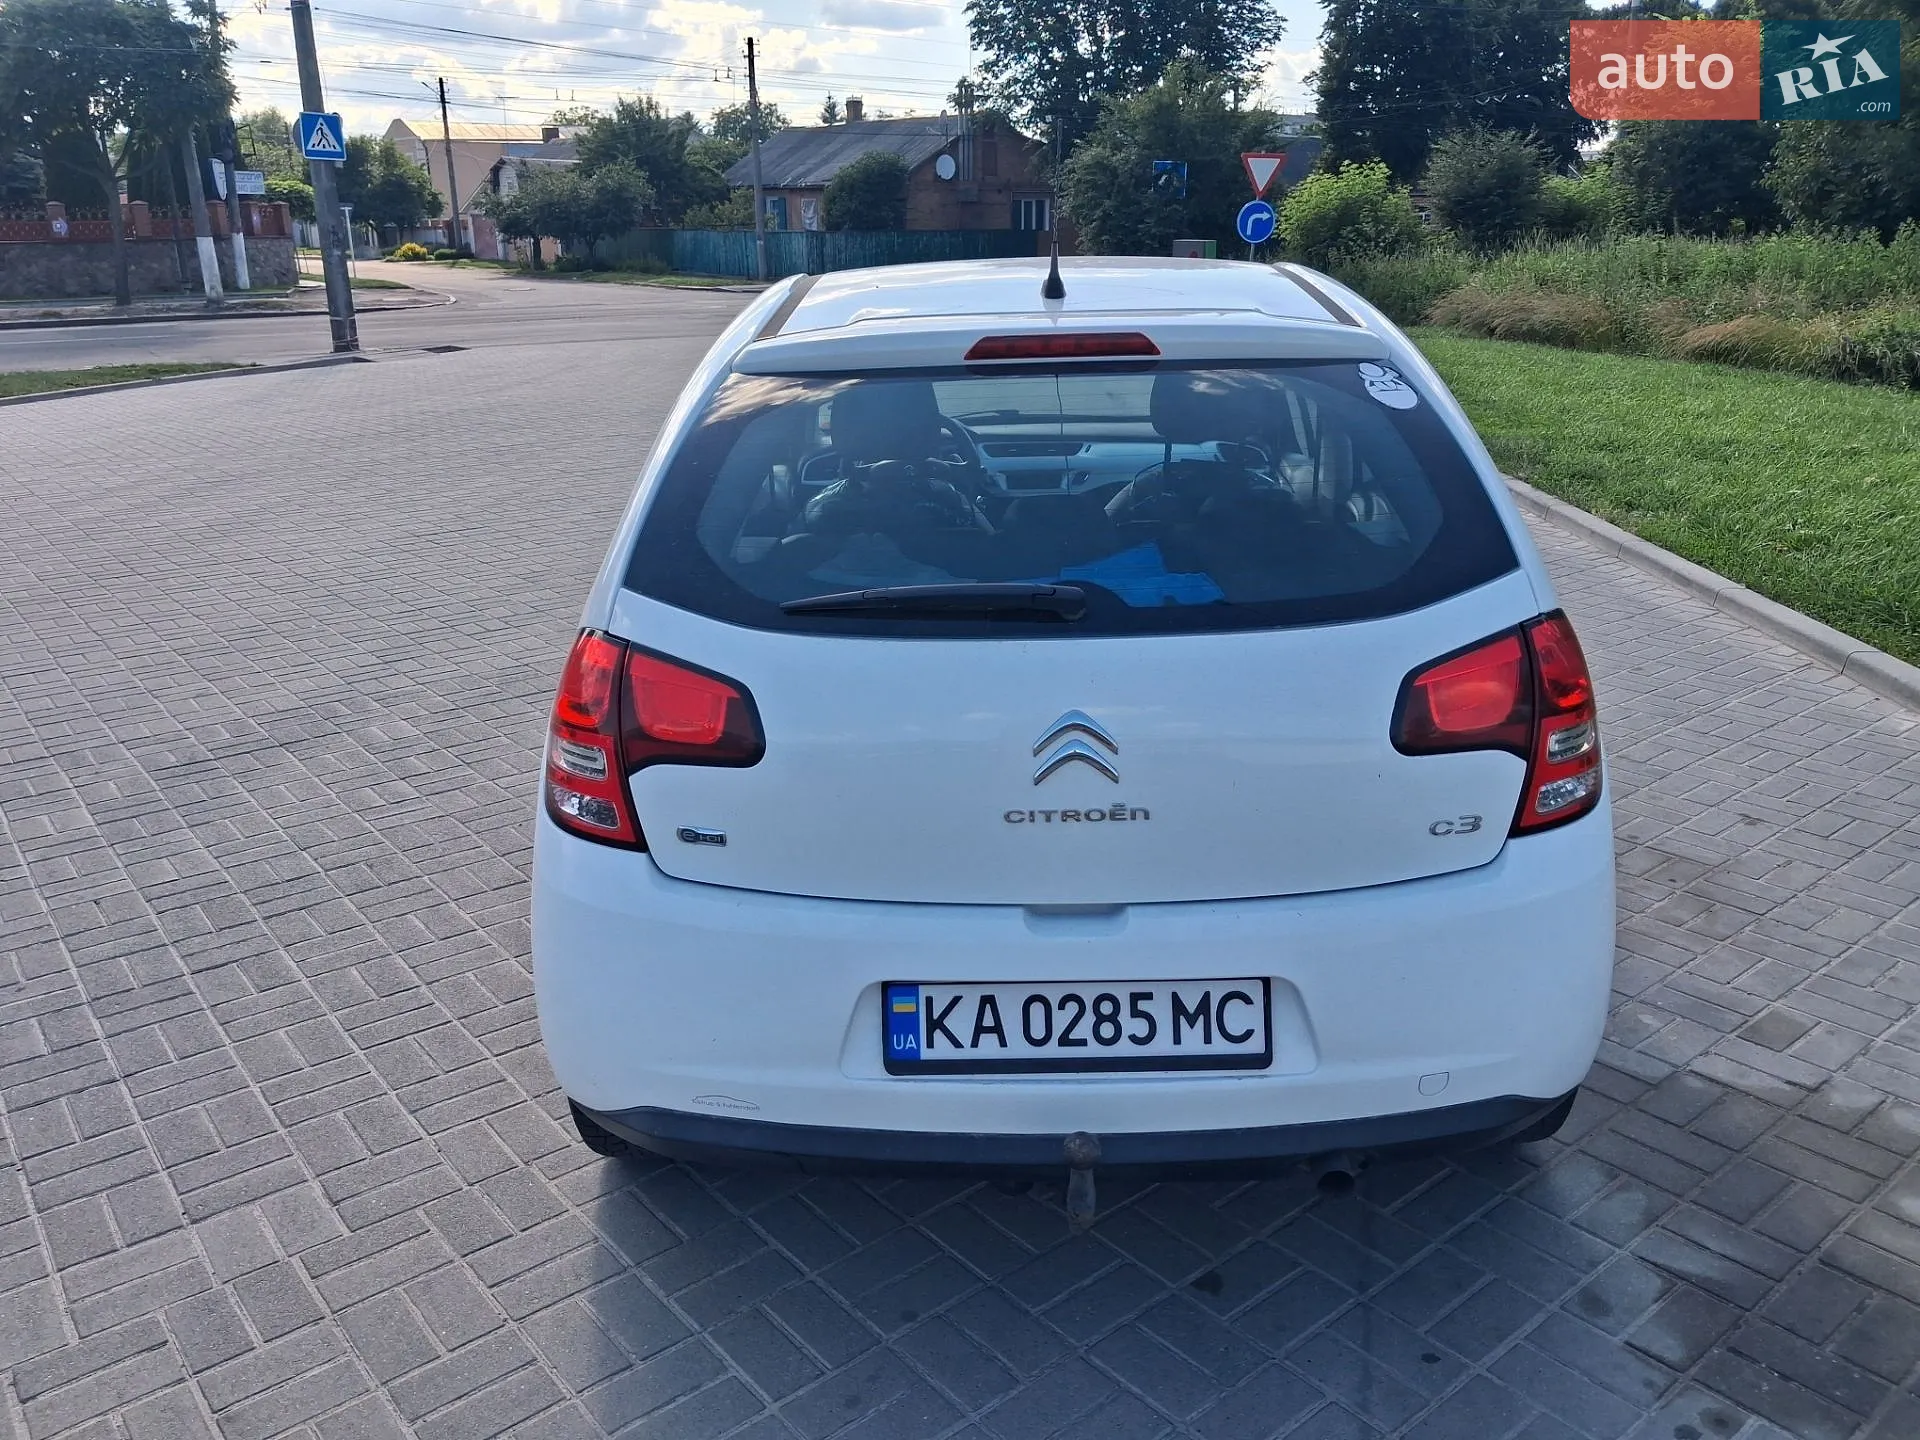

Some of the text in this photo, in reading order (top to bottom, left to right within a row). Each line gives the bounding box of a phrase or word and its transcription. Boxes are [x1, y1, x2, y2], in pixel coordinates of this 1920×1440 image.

[1429, 814, 1483, 836] C3
[925, 990, 1256, 1049] KA 0285 MC
[893, 1033, 918, 1050] UA
